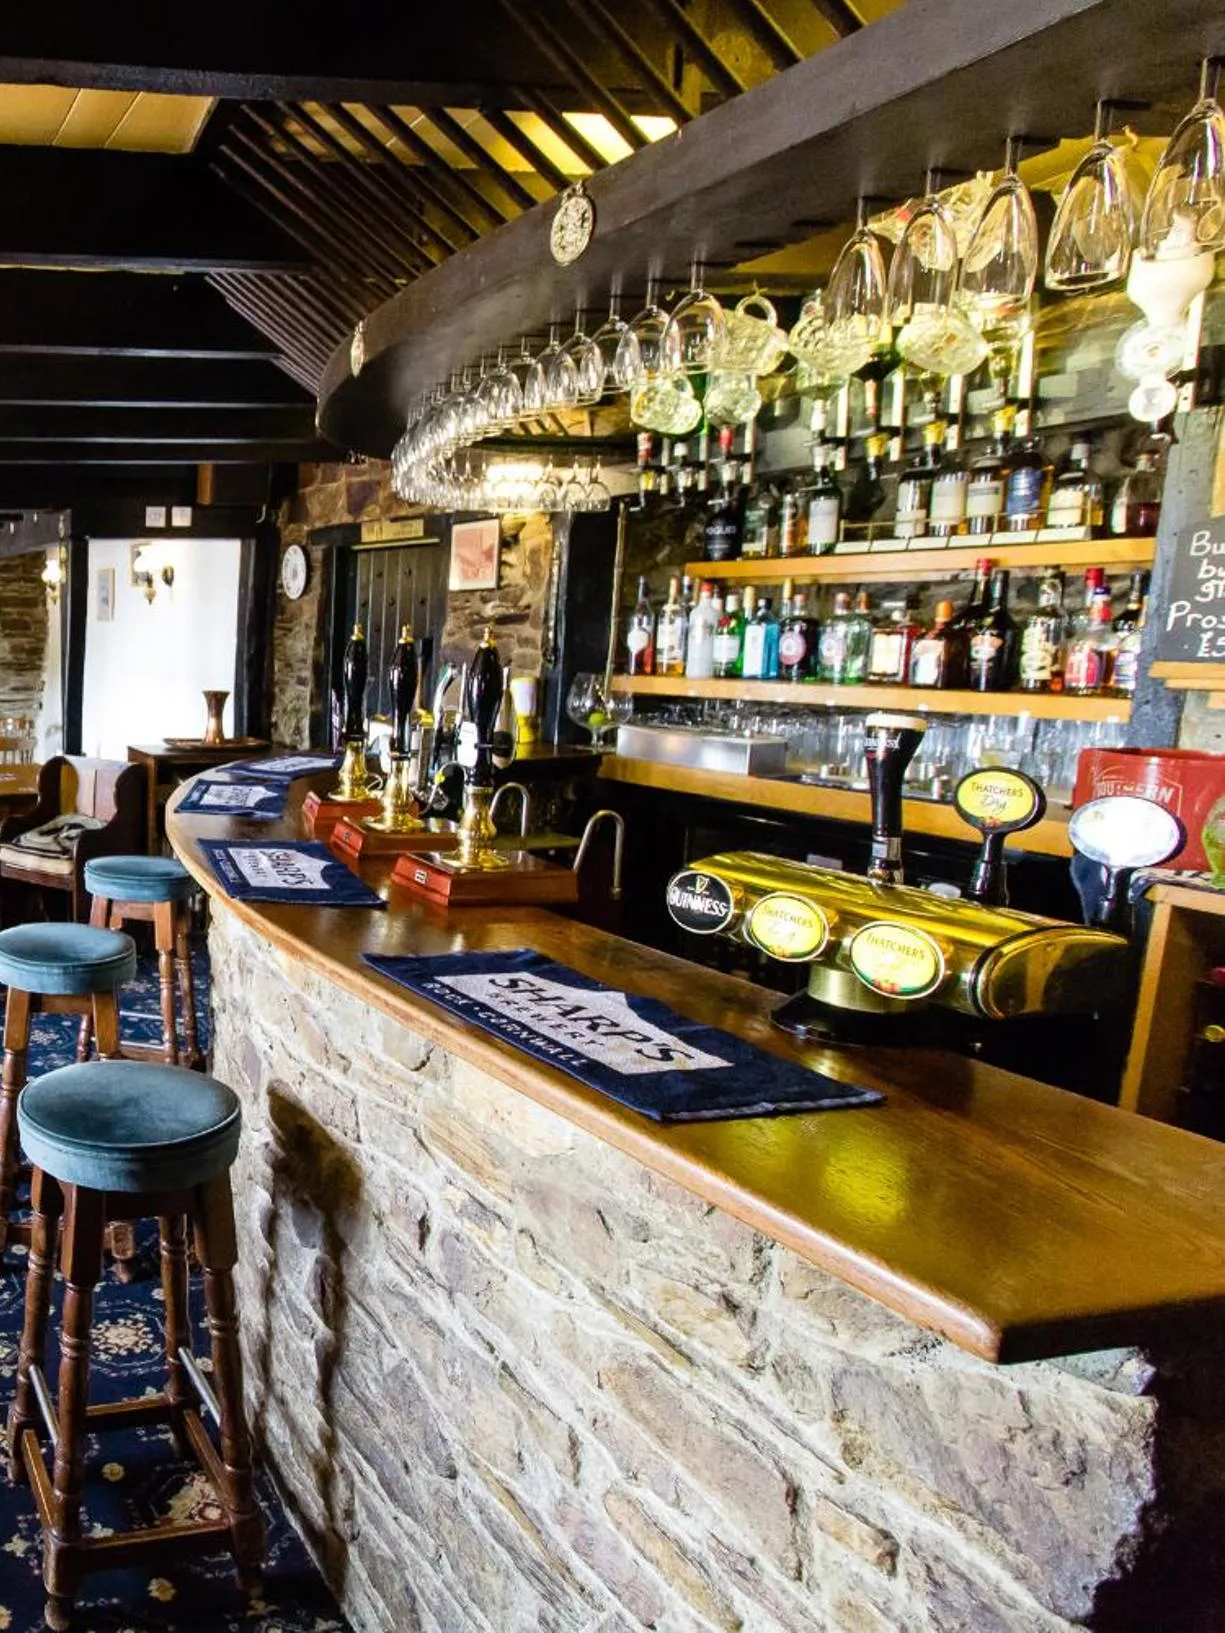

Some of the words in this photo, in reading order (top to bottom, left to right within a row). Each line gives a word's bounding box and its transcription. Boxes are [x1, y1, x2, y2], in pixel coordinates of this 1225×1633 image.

[971, 782, 1023, 797] THATCHERS
[667, 886, 729, 917] GUINNESS
[866, 932, 924, 960] THATCHERS
[485, 991, 604, 1047] BREWERY
[488, 978, 695, 1062] SHARP'S
